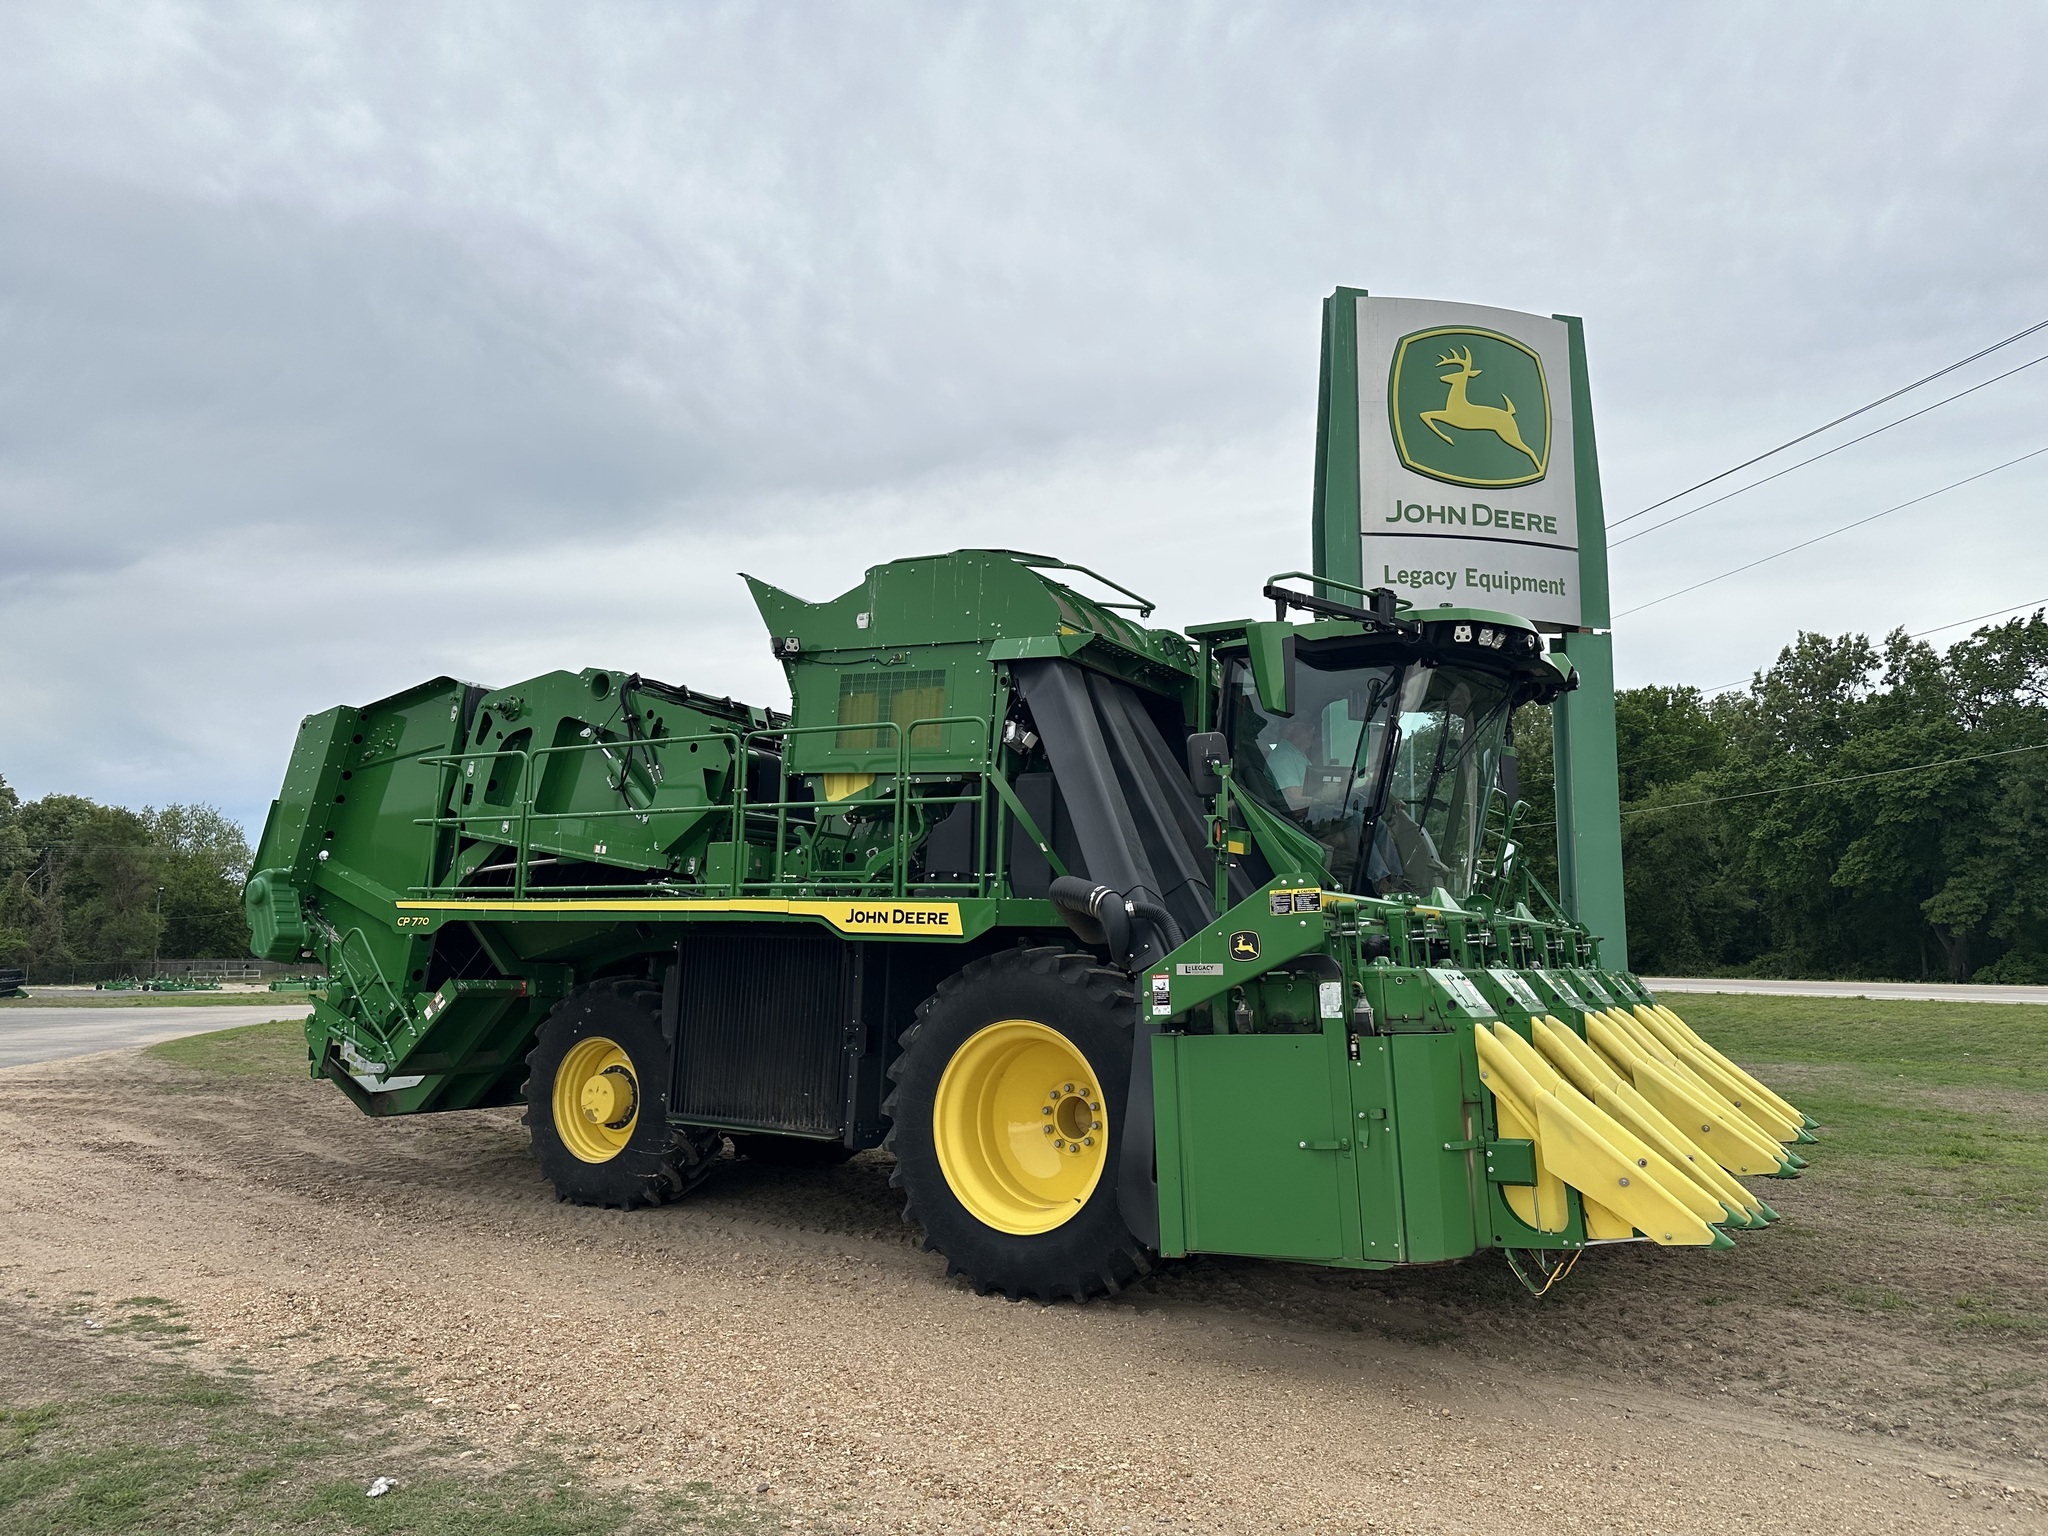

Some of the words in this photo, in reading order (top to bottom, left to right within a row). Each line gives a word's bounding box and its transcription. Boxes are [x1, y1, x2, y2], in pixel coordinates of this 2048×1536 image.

[1385, 499, 1466, 525] JOHN
[1472, 503, 1558, 535] DEERE
[1384, 564, 1457, 590] Legacy
[1465, 567, 1566, 596] Equipment
[397, 917, 410, 926] CP
[411, 917, 430, 926] 770
[846, 909, 888, 924] JOHN
[893, 909, 949, 925] DEERE
